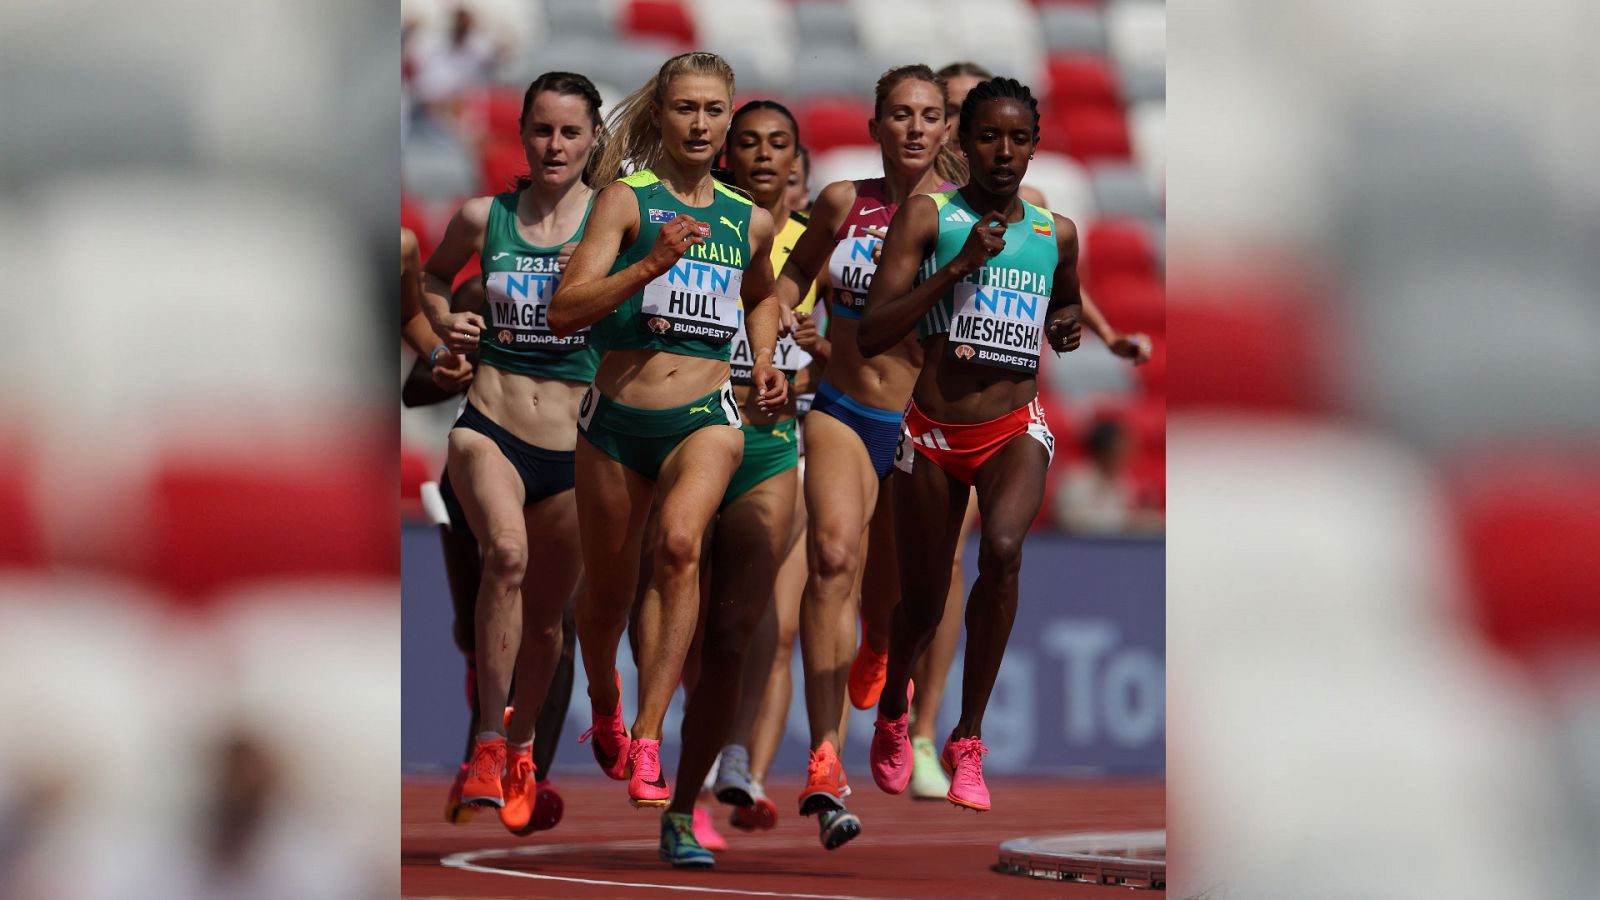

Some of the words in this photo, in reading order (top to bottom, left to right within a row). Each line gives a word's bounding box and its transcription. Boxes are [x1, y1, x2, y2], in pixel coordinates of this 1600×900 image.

[690, 242, 742, 268] TRALIA
[668, 261, 731, 295] NTN
[495, 302, 547, 327] MAGE
[668, 290, 721, 322] HULL
[974, 287, 1037, 321] NTN
[516, 334, 572, 344] BUDAPEST
[573, 336, 585, 344] 23
[674, 323, 724, 339] BUDAPEST
[955, 315, 1040, 351] MESHESHA
[979, 350, 1028, 367] BUDAPEST
[1028, 359, 1037, 369] 23
